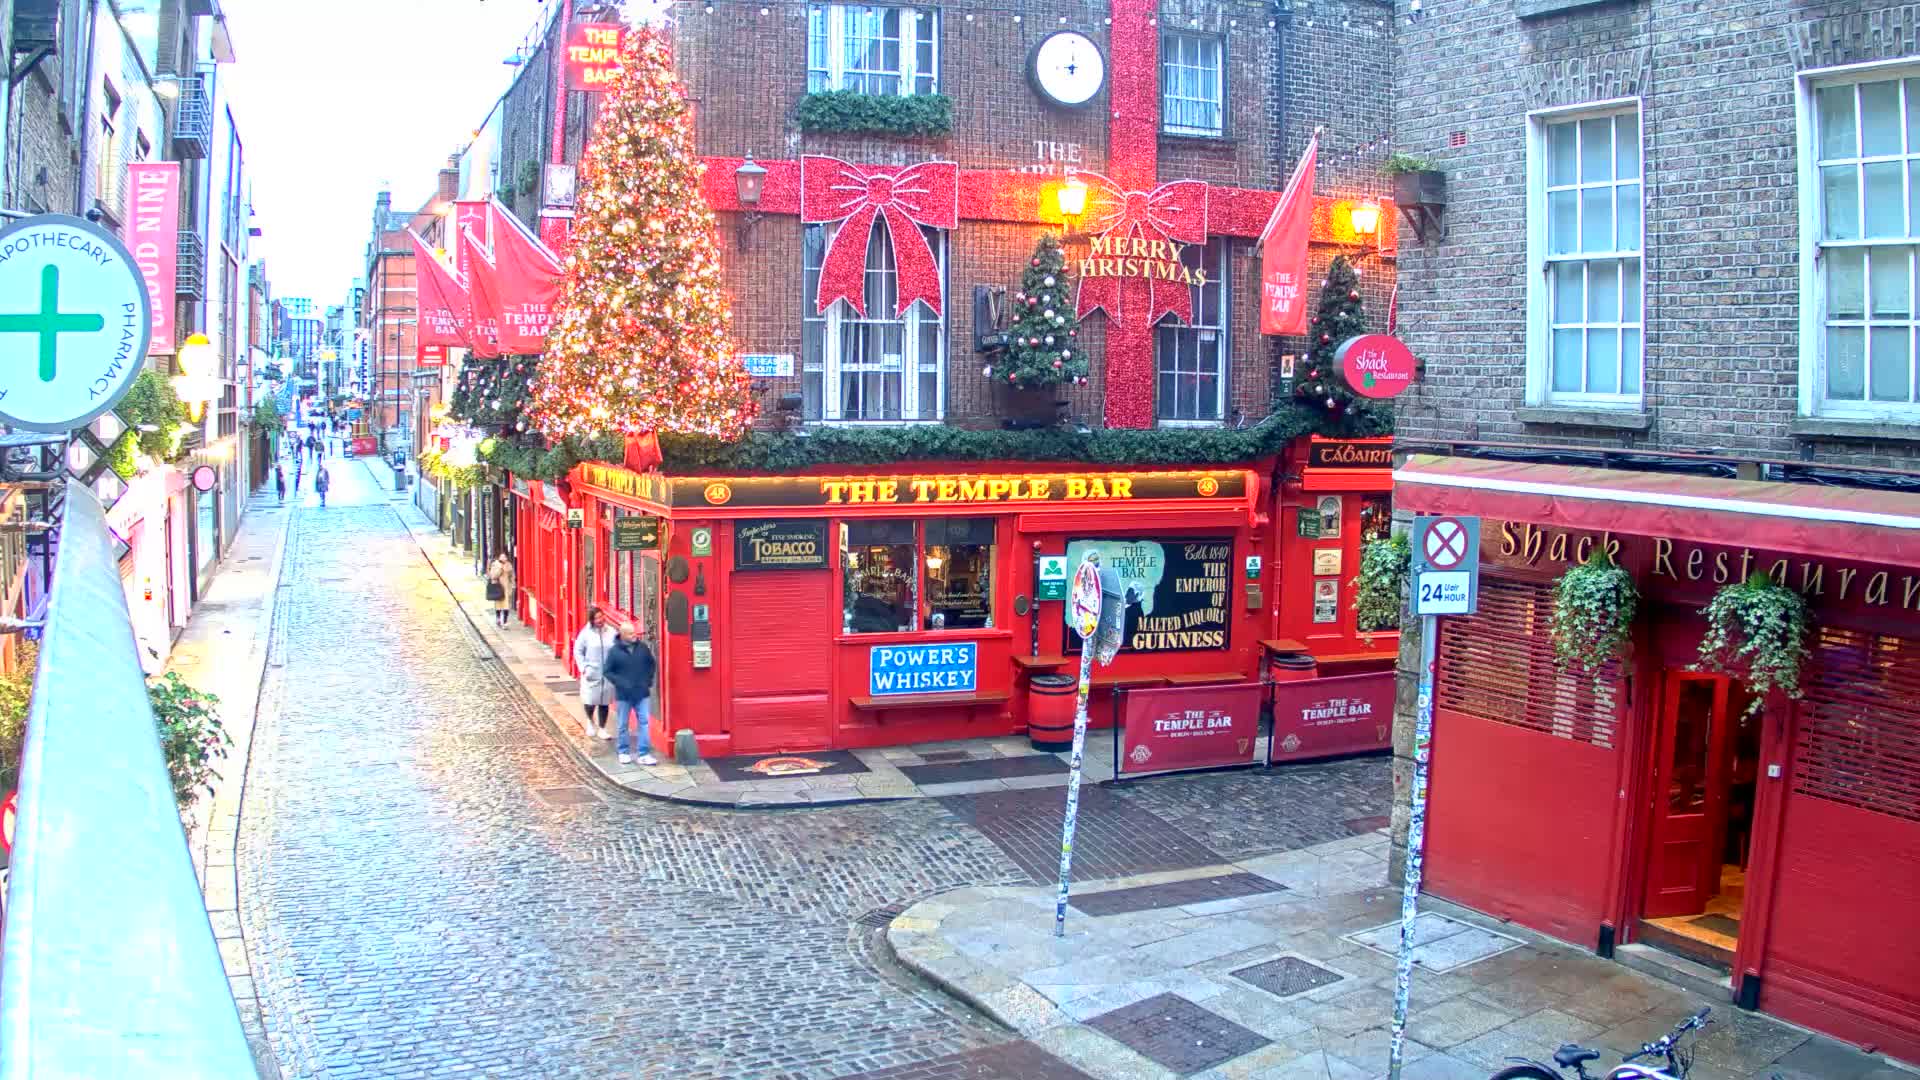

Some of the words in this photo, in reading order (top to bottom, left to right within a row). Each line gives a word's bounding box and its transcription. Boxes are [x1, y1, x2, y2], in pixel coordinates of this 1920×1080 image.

[584, 28, 618, 46] THE
[1033, 140, 1081, 162] THE
[137, 171, 168, 232] NINE
[1089, 236, 1185, 261] MERRY
[521, 303, 547, 312] THE
[88, 303, 136, 400] PHARMACY
[1356, 349, 1387, 373] Shack
[709, 487, 725, 499] 48
[823, 479, 899, 503] THE
[911, 478, 1050, 503] TEMPLE
[1065, 477, 1133, 500] BAR
[751, 538, 816, 562] TOBACCO
[1121, 546, 1148, 557] THE
[1500, 520, 1620, 567] Shack
[1111, 557, 1157, 568] TEMPLE
[1203, 562, 1226, 577] THE
[1122, 567, 1146, 578] BAR
[1176, 577, 1226, 592] EMPEROR
[1421, 583, 1443, 602] 24
[1211, 592, 1225, 607] OF
[1444, 593, 1467, 602] HOUR
[1137, 615, 1181, 632] MALTED
[1183, 608, 1226, 629] LIQUORS
[1132, 630, 1225, 650] GUINNESS
[880, 648, 969, 667] POWER'S
[874, 670, 973, 689] WHISKEY
[1302, 706, 1347, 720] TEMPLE
[1349, 703, 1372, 715] BAR
[1328, 698, 1348, 707] THE
[1154, 719, 1204, 731] TEMPLE
[1207, 716, 1232, 728] BAR
[1184, 710, 1205, 719] THE
